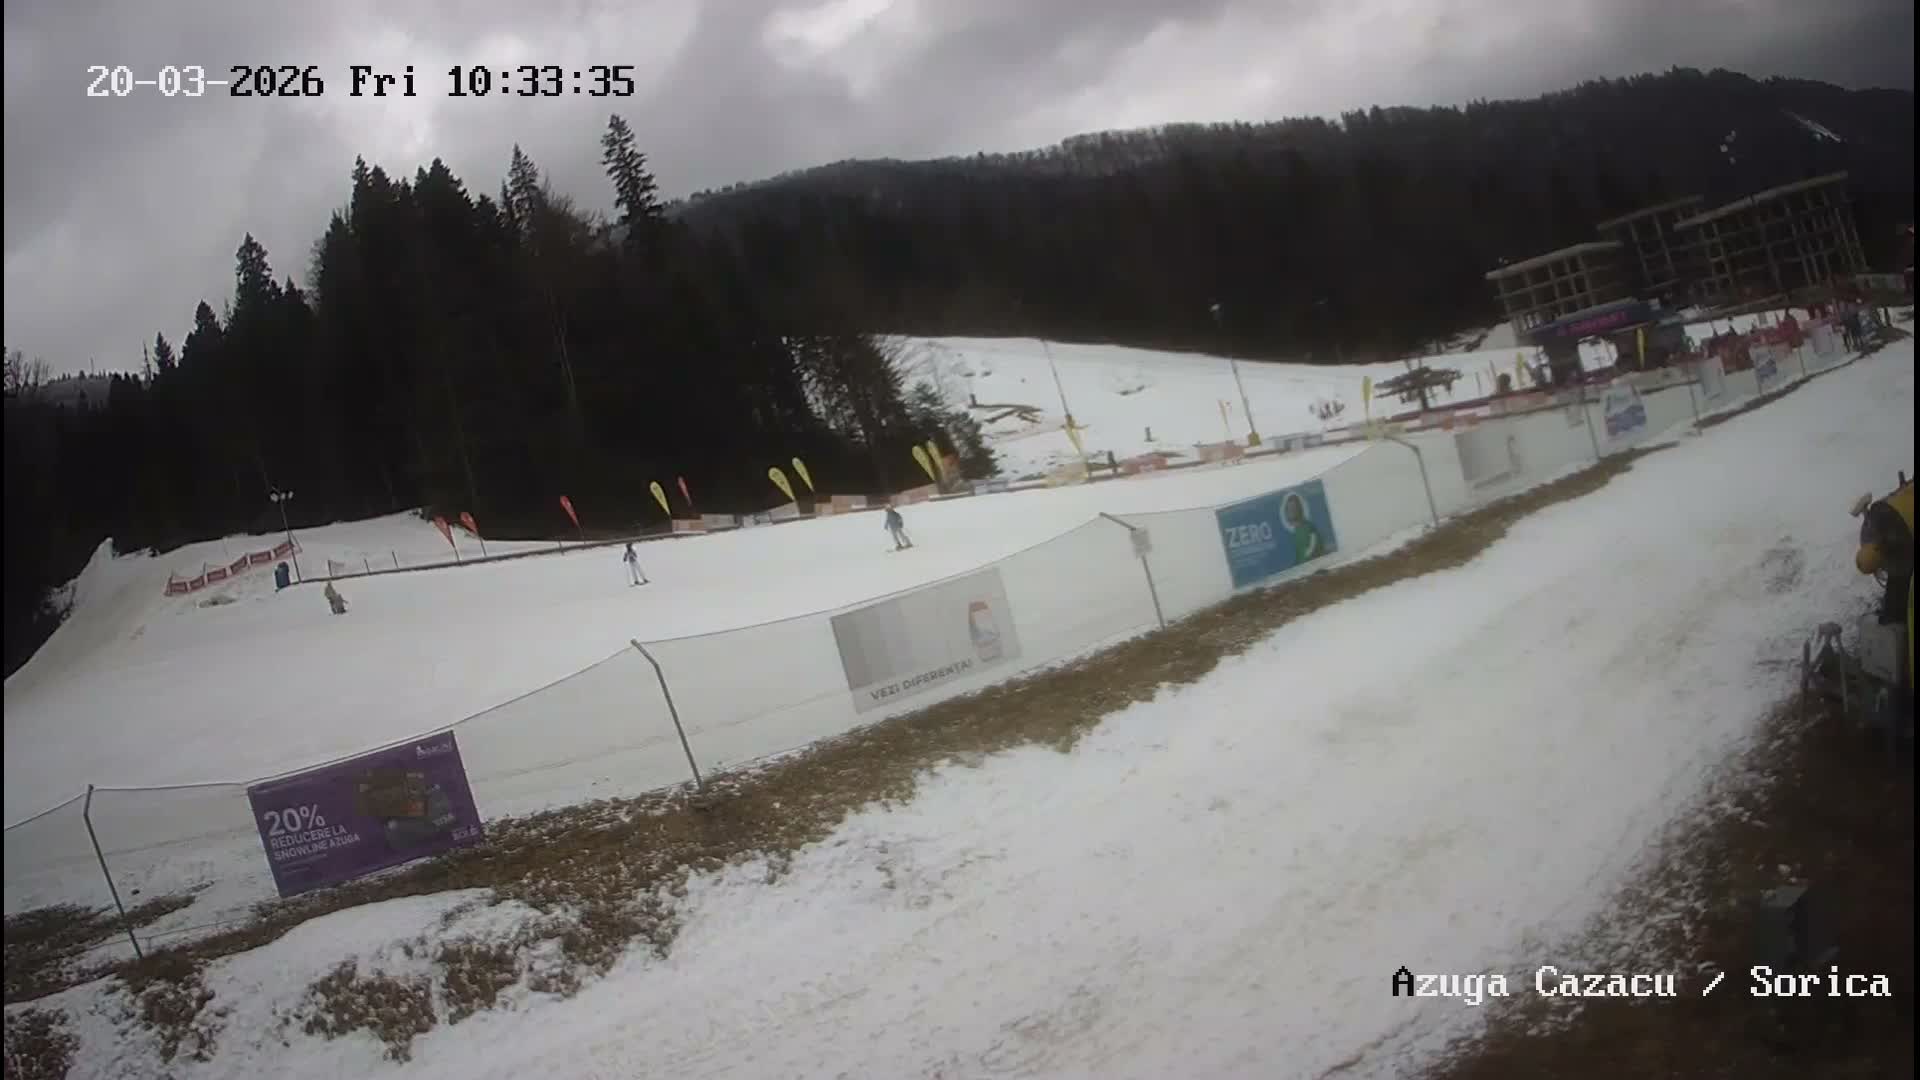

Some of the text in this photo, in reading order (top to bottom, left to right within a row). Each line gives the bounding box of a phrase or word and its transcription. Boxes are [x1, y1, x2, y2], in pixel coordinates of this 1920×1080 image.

[1224, 521, 1273, 548] ZERO
[263, 803, 326, 837] 20%
[270, 824, 348, 850] REDUCERE LA
[274, 833, 361, 861] SNOWLINE AZUGA
